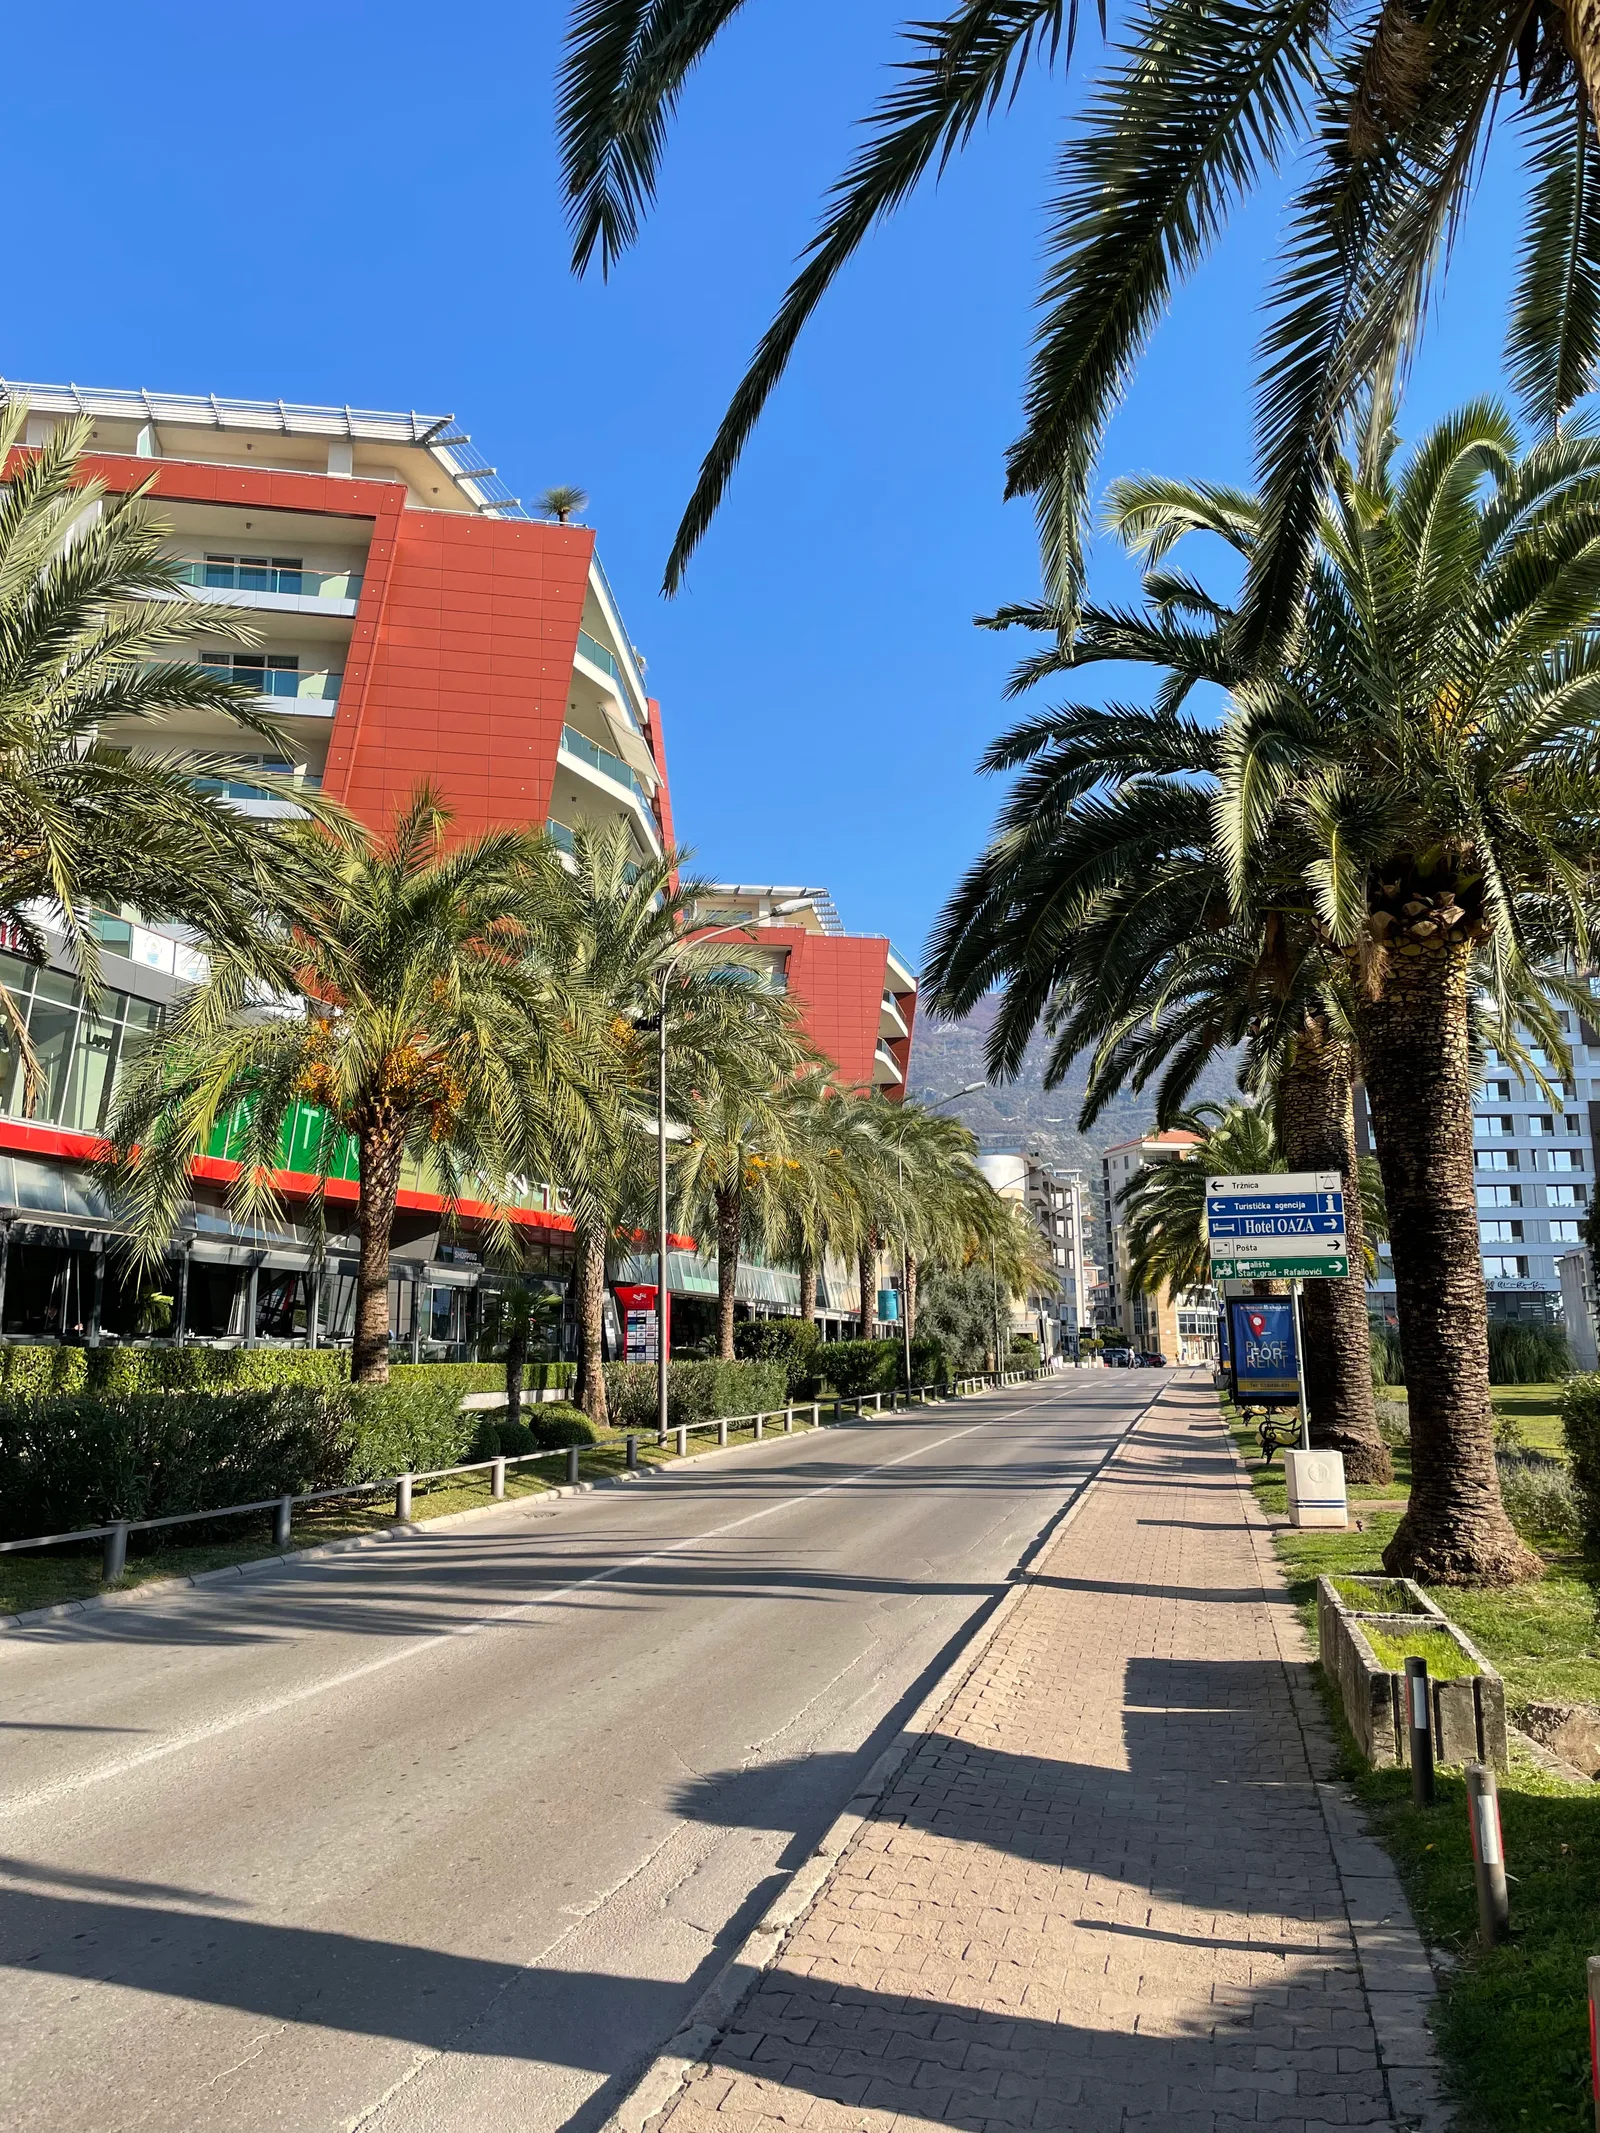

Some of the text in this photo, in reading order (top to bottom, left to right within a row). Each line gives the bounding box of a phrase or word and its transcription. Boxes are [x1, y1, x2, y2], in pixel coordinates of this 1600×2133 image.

[1232, 1181, 1259, 1189] Tržnica
[1234, 1201, 1306, 1211] Turistička agencija
[1245, 1218, 1315, 1234] Hotel OAZA
[454, 1250, 478, 1261] SHOPPING
[1237, 1260, 1270, 1269] alište
[1238, 1269, 1256, 1277] Stari
[1260, 1269, 1277, 1278] grad
[1284, 1268, 1322, 1276] Rafailovići
[1246, 1341, 1287, 1352] PLACE
[1251, 1348, 1282, 1360] FOR
[1247, 1355, 1288, 1368] RENT
